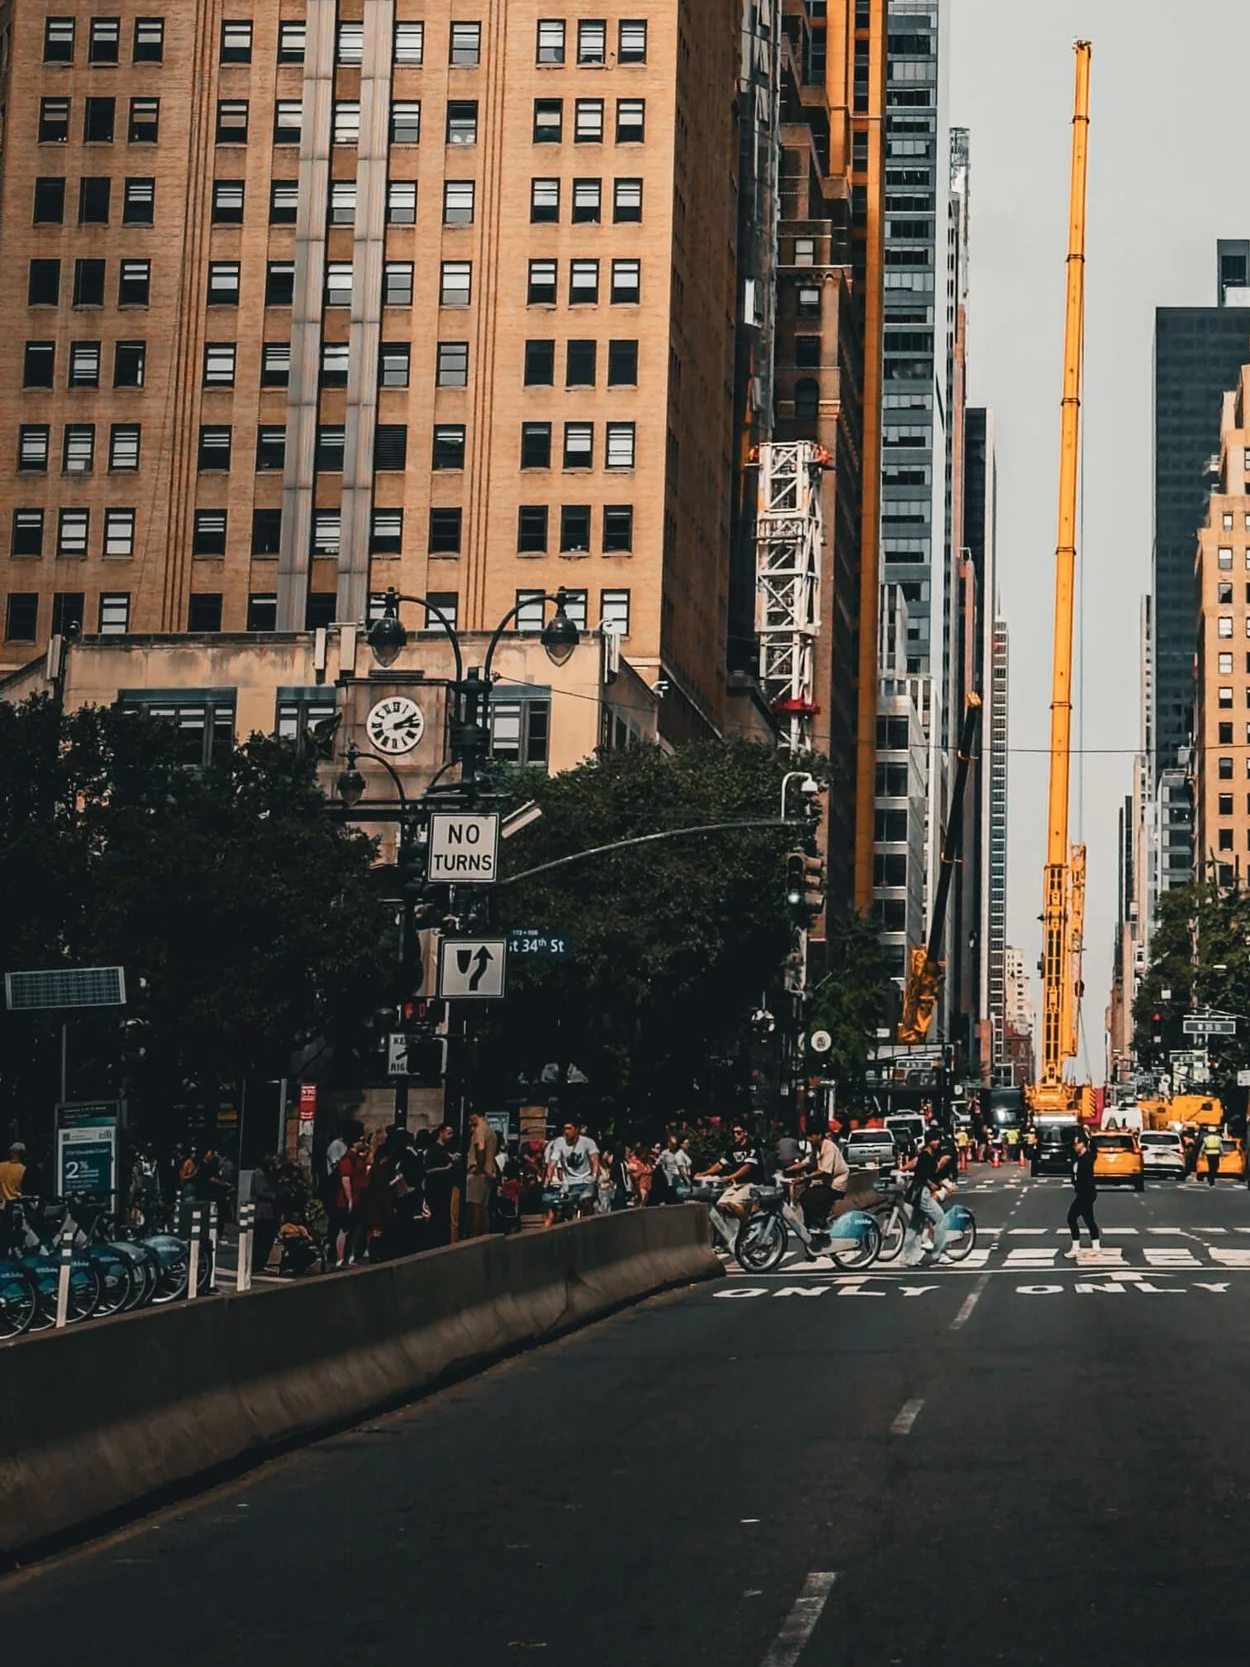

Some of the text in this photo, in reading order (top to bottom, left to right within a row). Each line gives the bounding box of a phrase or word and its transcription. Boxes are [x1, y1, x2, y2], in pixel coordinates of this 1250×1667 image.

[448, 824, 480, 844] NO
[434, 854, 492, 871] TURNS
[521, 937, 547, 953] 34th
[550, 938, 565, 953] St
[65, 1161, 89, 1180] 2%
[712, 1285, 940, 1298] ONLY
[1015, 1282, 1232, 1295] ONLY
